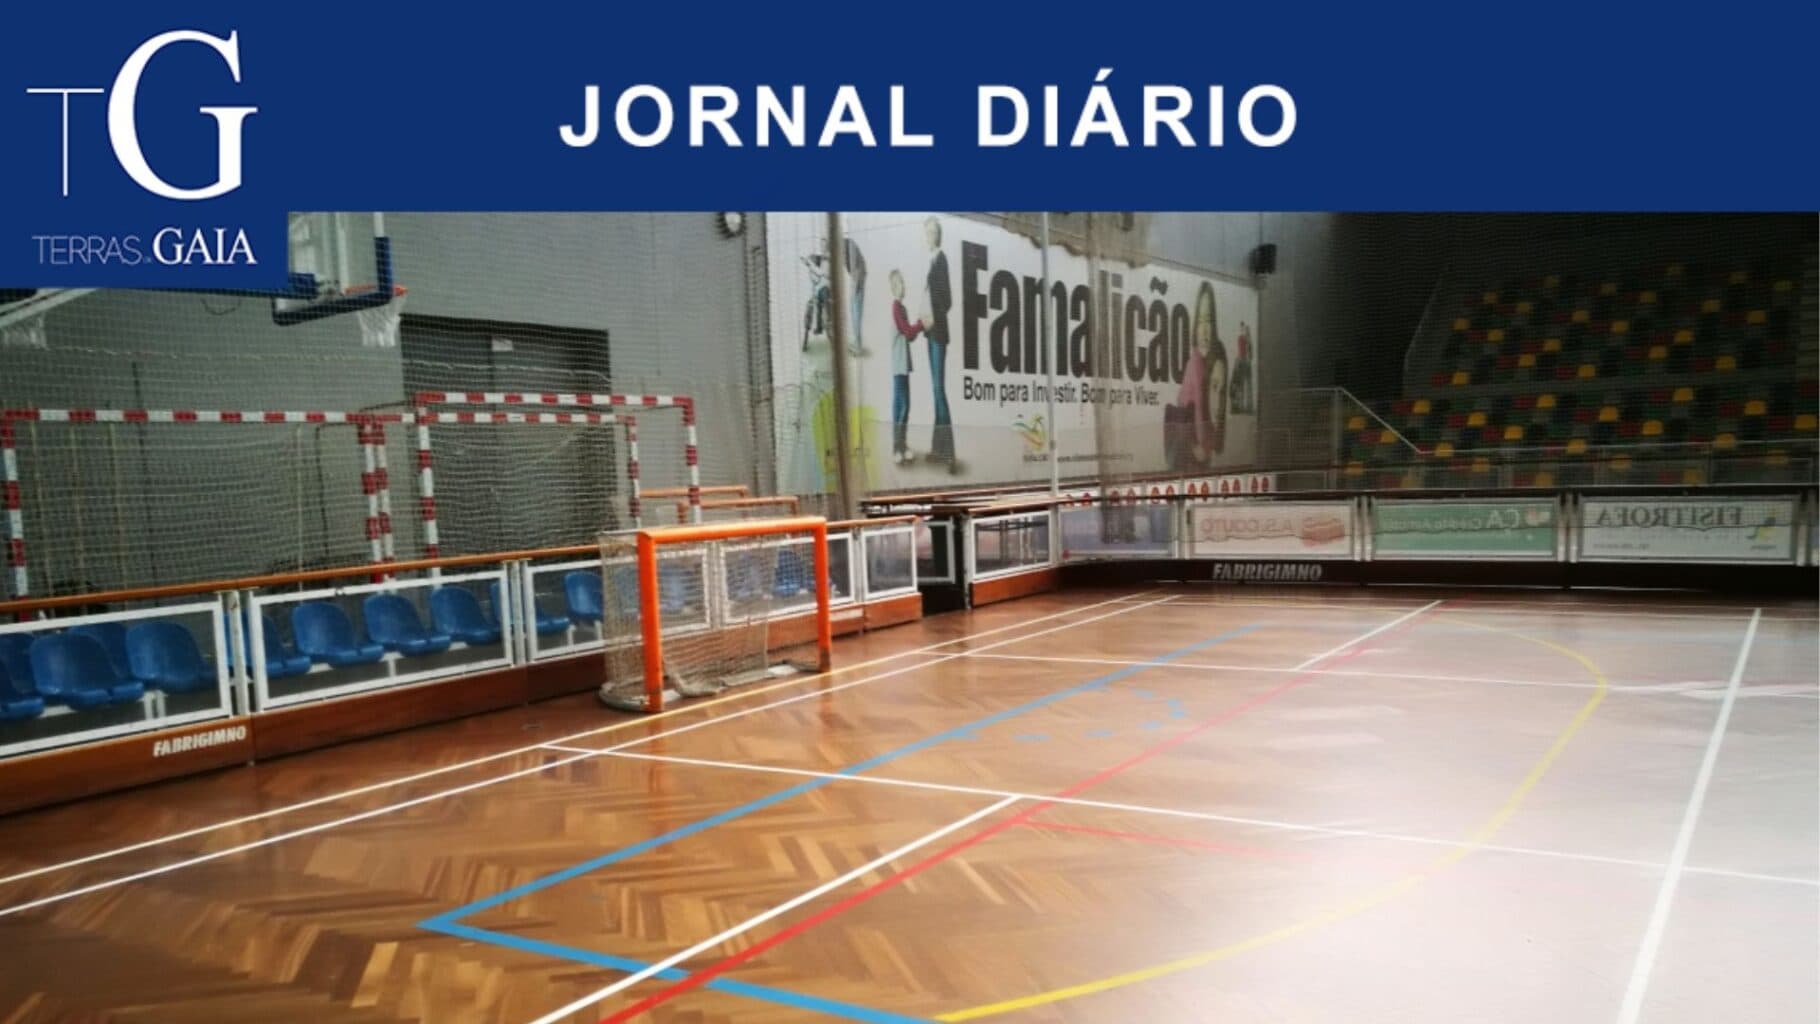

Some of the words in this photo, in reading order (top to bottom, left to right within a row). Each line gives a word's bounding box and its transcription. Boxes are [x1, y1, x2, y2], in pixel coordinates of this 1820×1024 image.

[961, 240, 1191, 384] Famalicão
[963, 376, 995, 401] Bom
[1001, 383, 1029, 408] para
[1212, 563, 1322, 580] FABRIGIMNO
[153, 725, 247, 757] FABRIGIMNO
